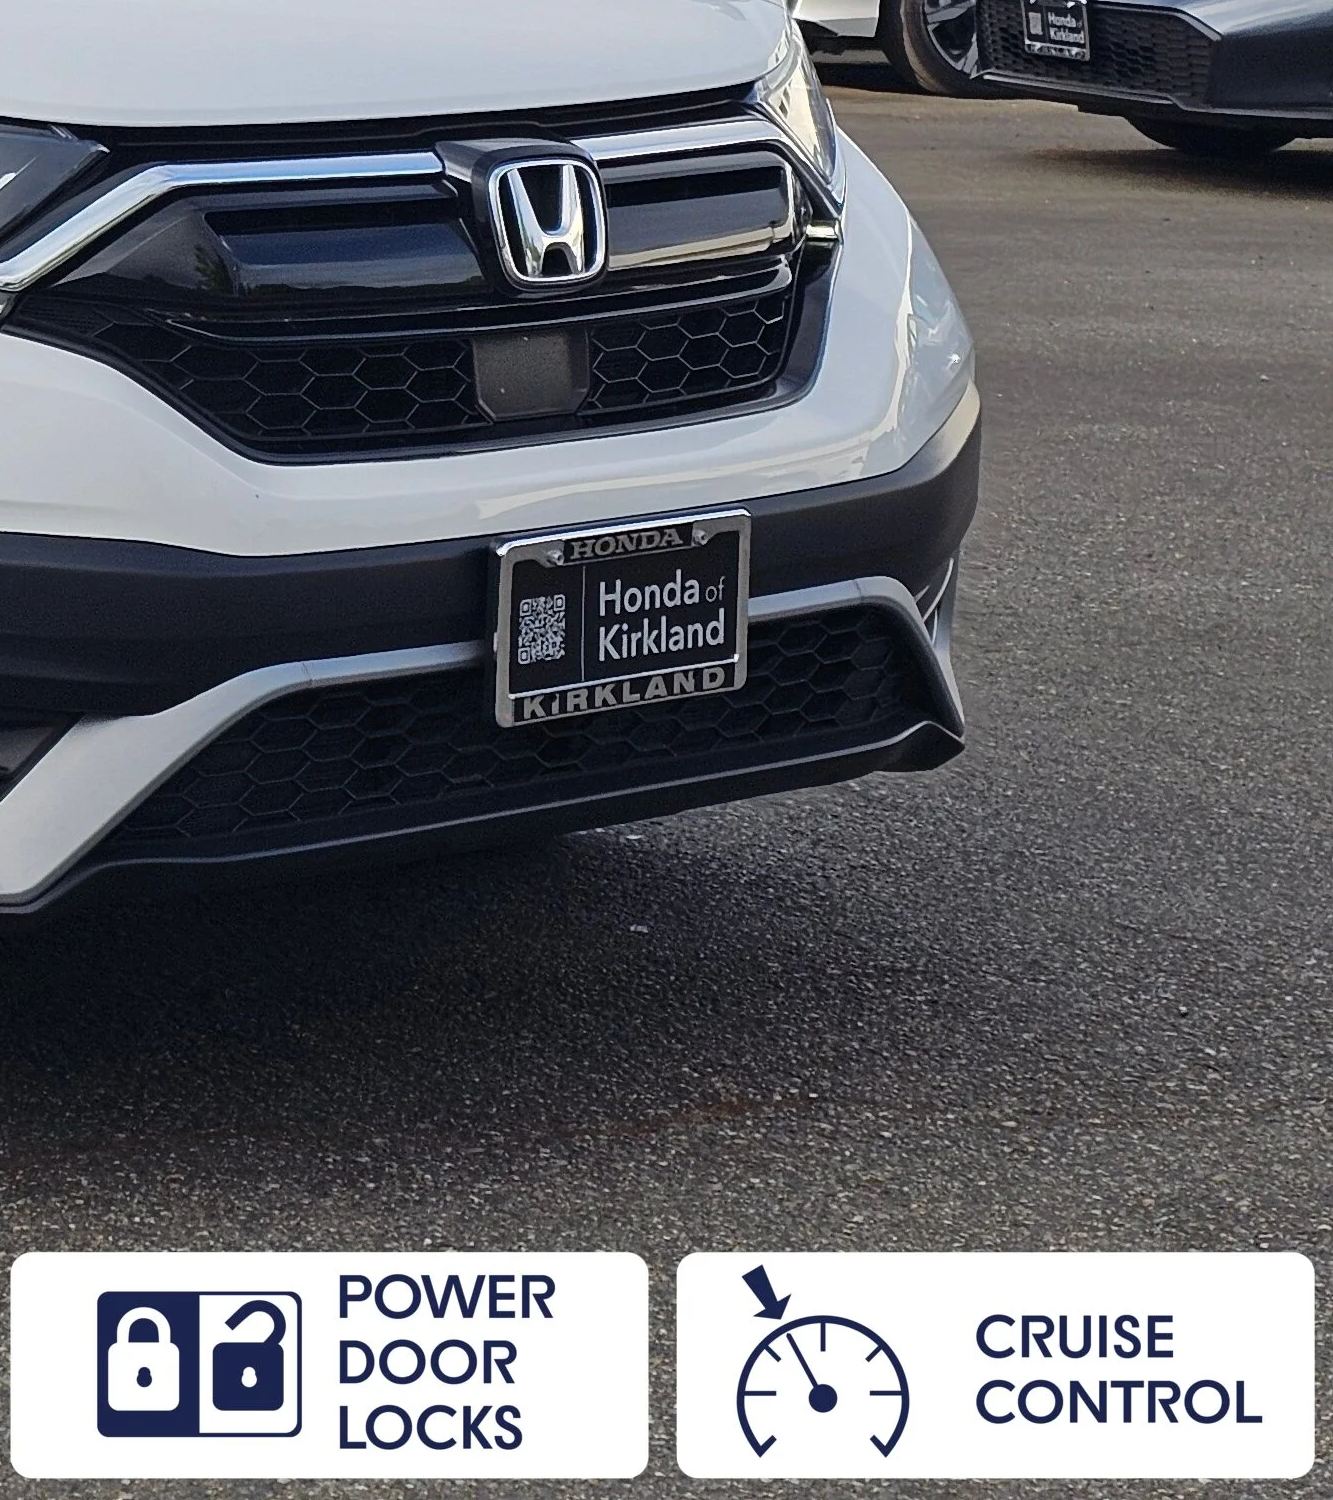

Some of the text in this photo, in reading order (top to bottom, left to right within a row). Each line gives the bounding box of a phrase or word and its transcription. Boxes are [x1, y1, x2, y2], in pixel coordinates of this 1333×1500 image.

[569, 527, 684, 561] HONDA
[598, 568, 726, 618] Honda of
[598, 607, 726, 662] Kirkland
[522, 667, 727, 721] KIRKLAND
